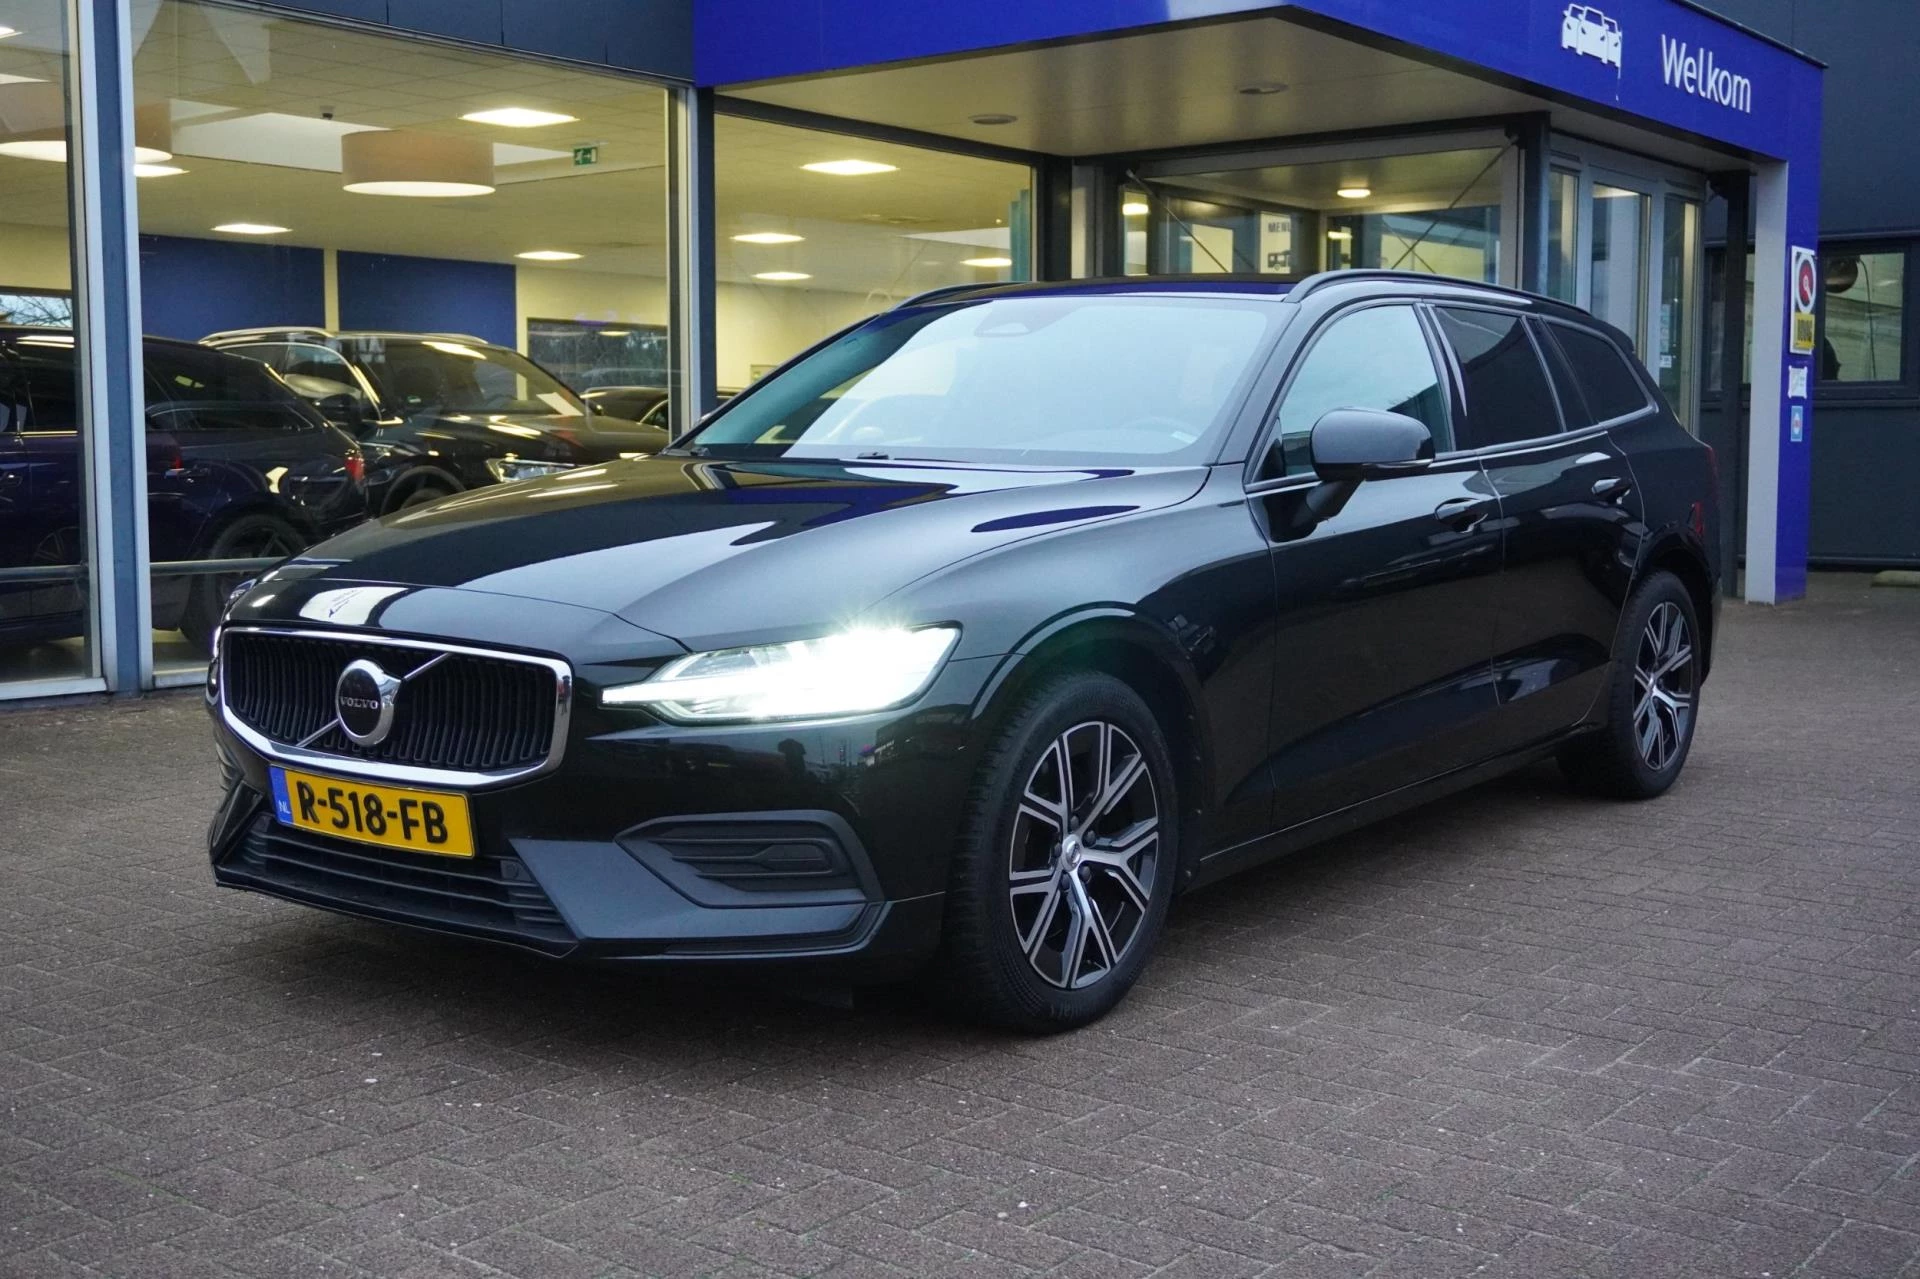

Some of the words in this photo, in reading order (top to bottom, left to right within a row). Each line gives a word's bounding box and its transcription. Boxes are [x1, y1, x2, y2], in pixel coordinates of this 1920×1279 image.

[1661, 34, 1751, 113] Welkom
[340, 696, 379, 710] VOLVO
[278, 800, 292, 815] NL
[296, 781, 448, 844] R-518-FB
